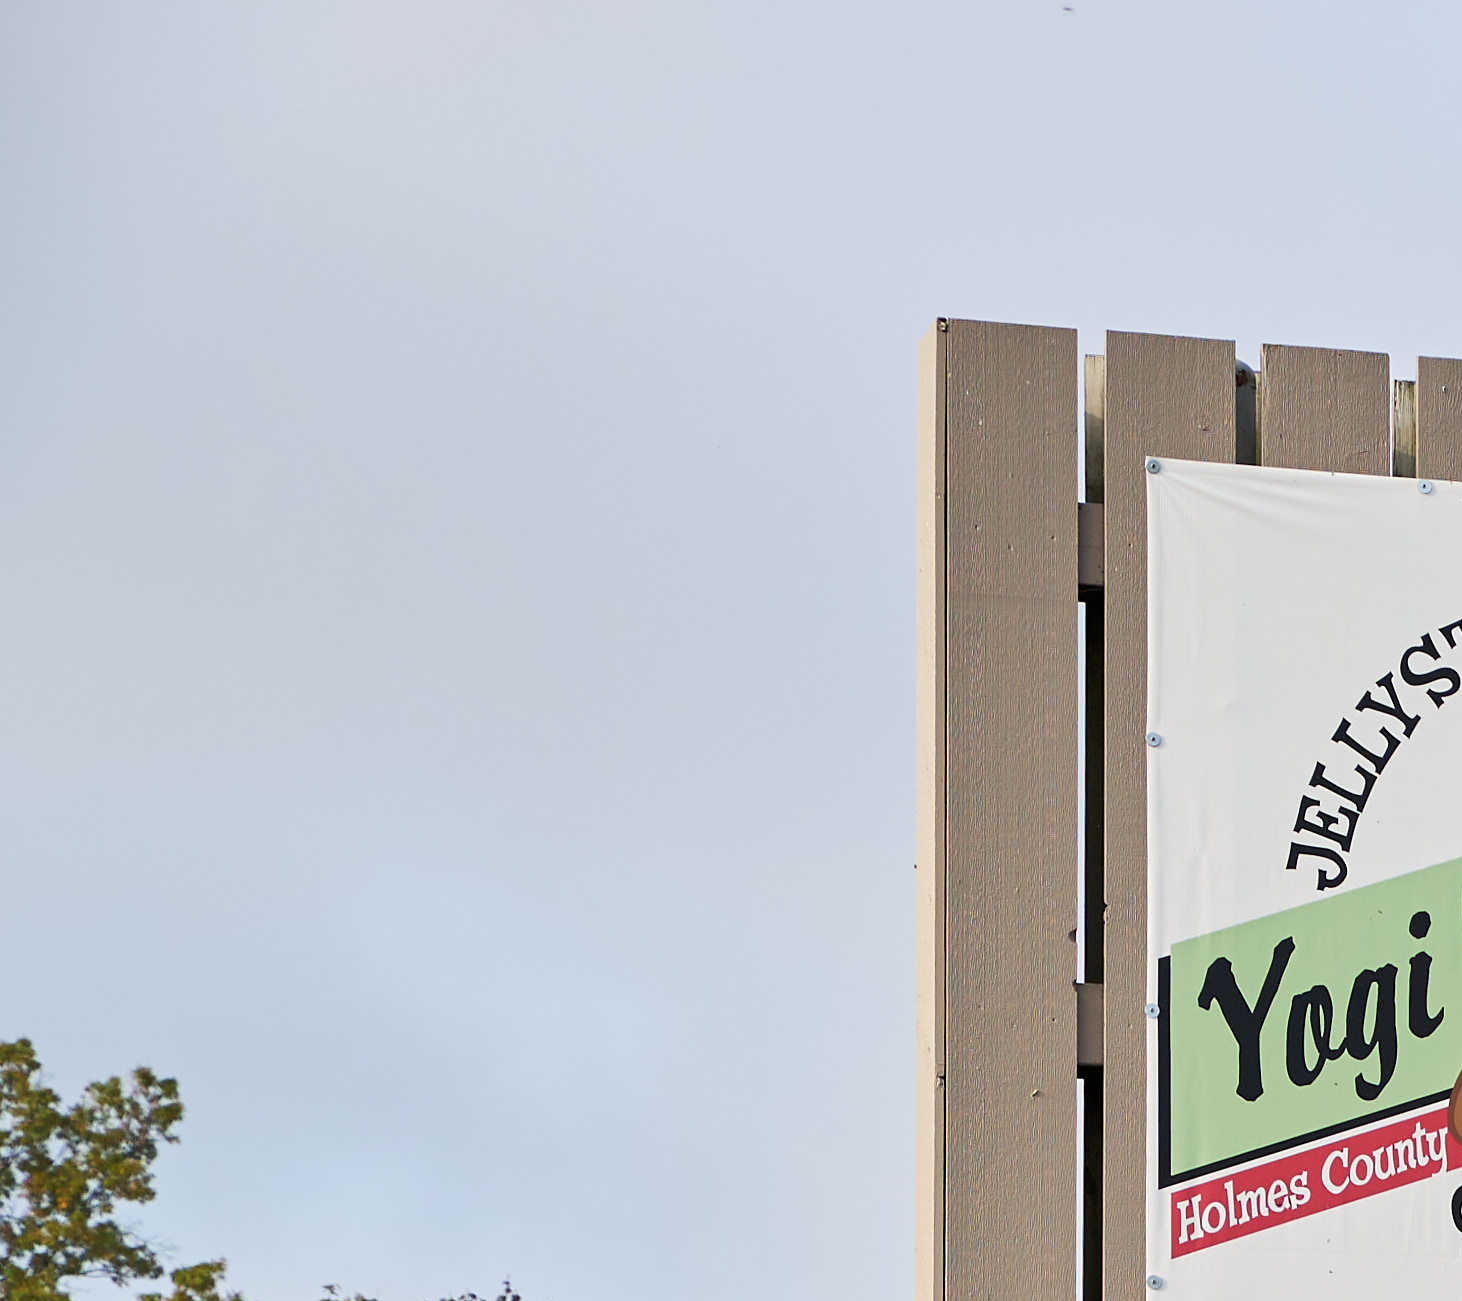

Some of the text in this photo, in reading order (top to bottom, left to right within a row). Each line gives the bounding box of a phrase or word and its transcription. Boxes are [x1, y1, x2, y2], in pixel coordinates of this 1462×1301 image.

[1198, 911, 1446, 1102] Yogi
[1176, 1121, 1449, 1244] Holmes County
